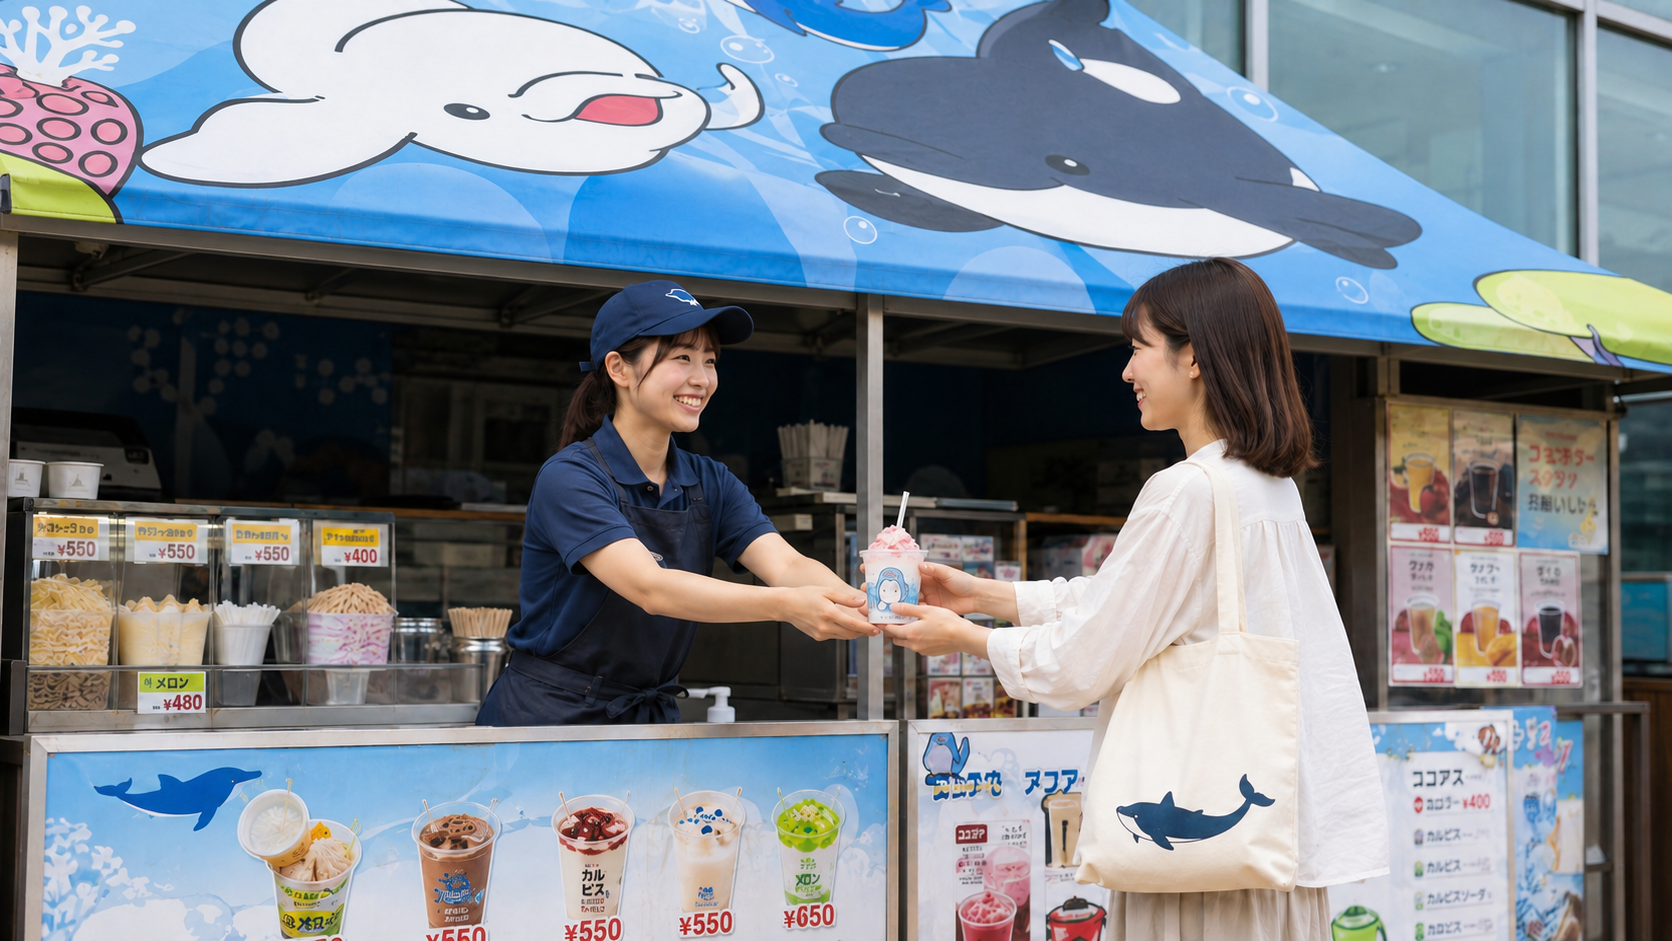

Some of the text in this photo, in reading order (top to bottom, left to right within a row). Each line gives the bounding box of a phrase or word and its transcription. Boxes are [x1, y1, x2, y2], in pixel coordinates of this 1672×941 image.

[57, 541, 96, 557] ¥550
[158, 544, 195, 559] ¥550
[255, 546, 290, 561] ¥550
[344, 549, 378, 564] ¥400
[156, 677, 189, 689] メロン
[163, 694, 203, 710] ¥480
[1413, 769, 1464, 788] ココアス
[1463, 793, 1491, 809] ¥400
[582, 869, 605, 882] カル
[795, 873, 820, 886] メロン
[582, 883, 605, 897] ビス
[679, 911, 733, 935] ¥550
[783, 904, 835, 928] ¥650
[564, 918, 622, 941] ¥550
